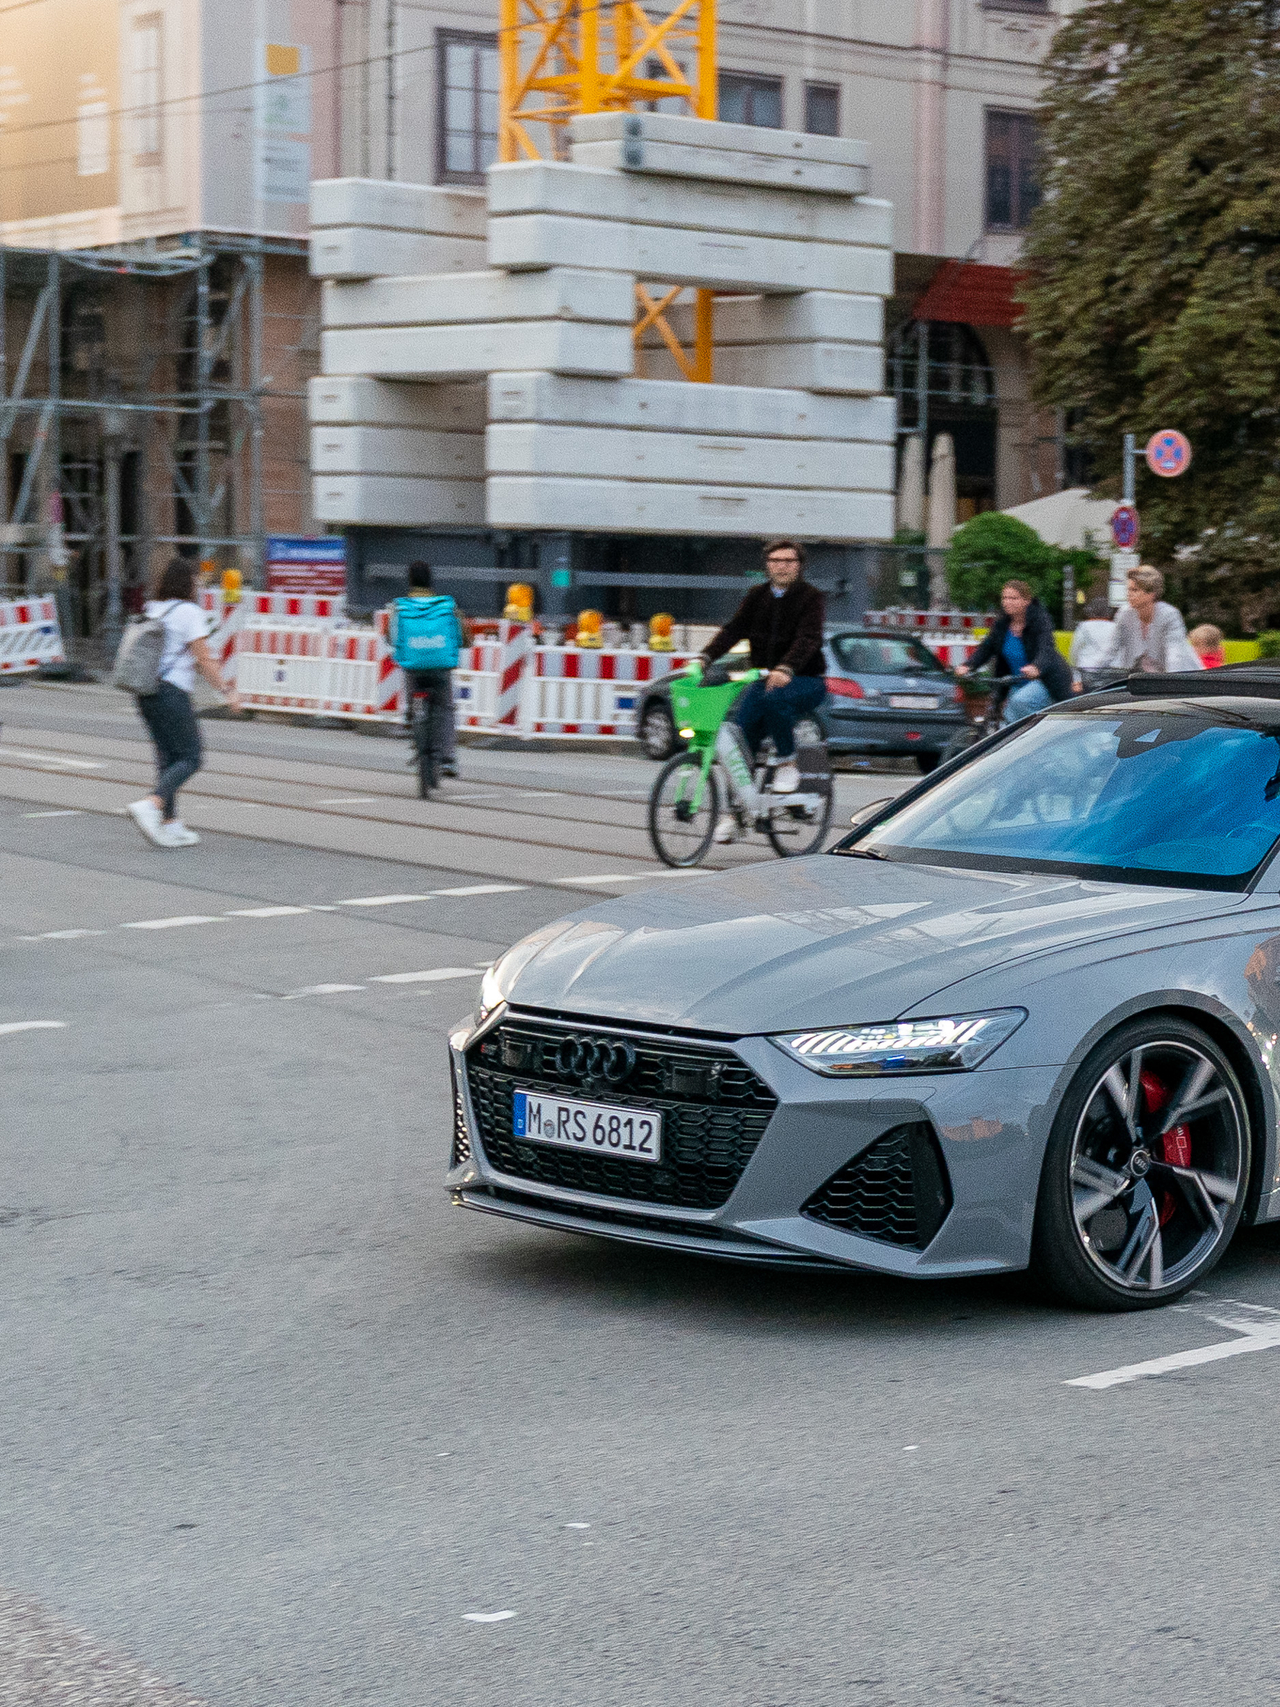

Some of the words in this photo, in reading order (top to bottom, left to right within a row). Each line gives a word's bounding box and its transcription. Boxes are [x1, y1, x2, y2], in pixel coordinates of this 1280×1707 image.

[528, 1101, 542, 1135] M
[557, 1106, 587, 1143] RS
[592, 1113, 653, 1154] 6812
